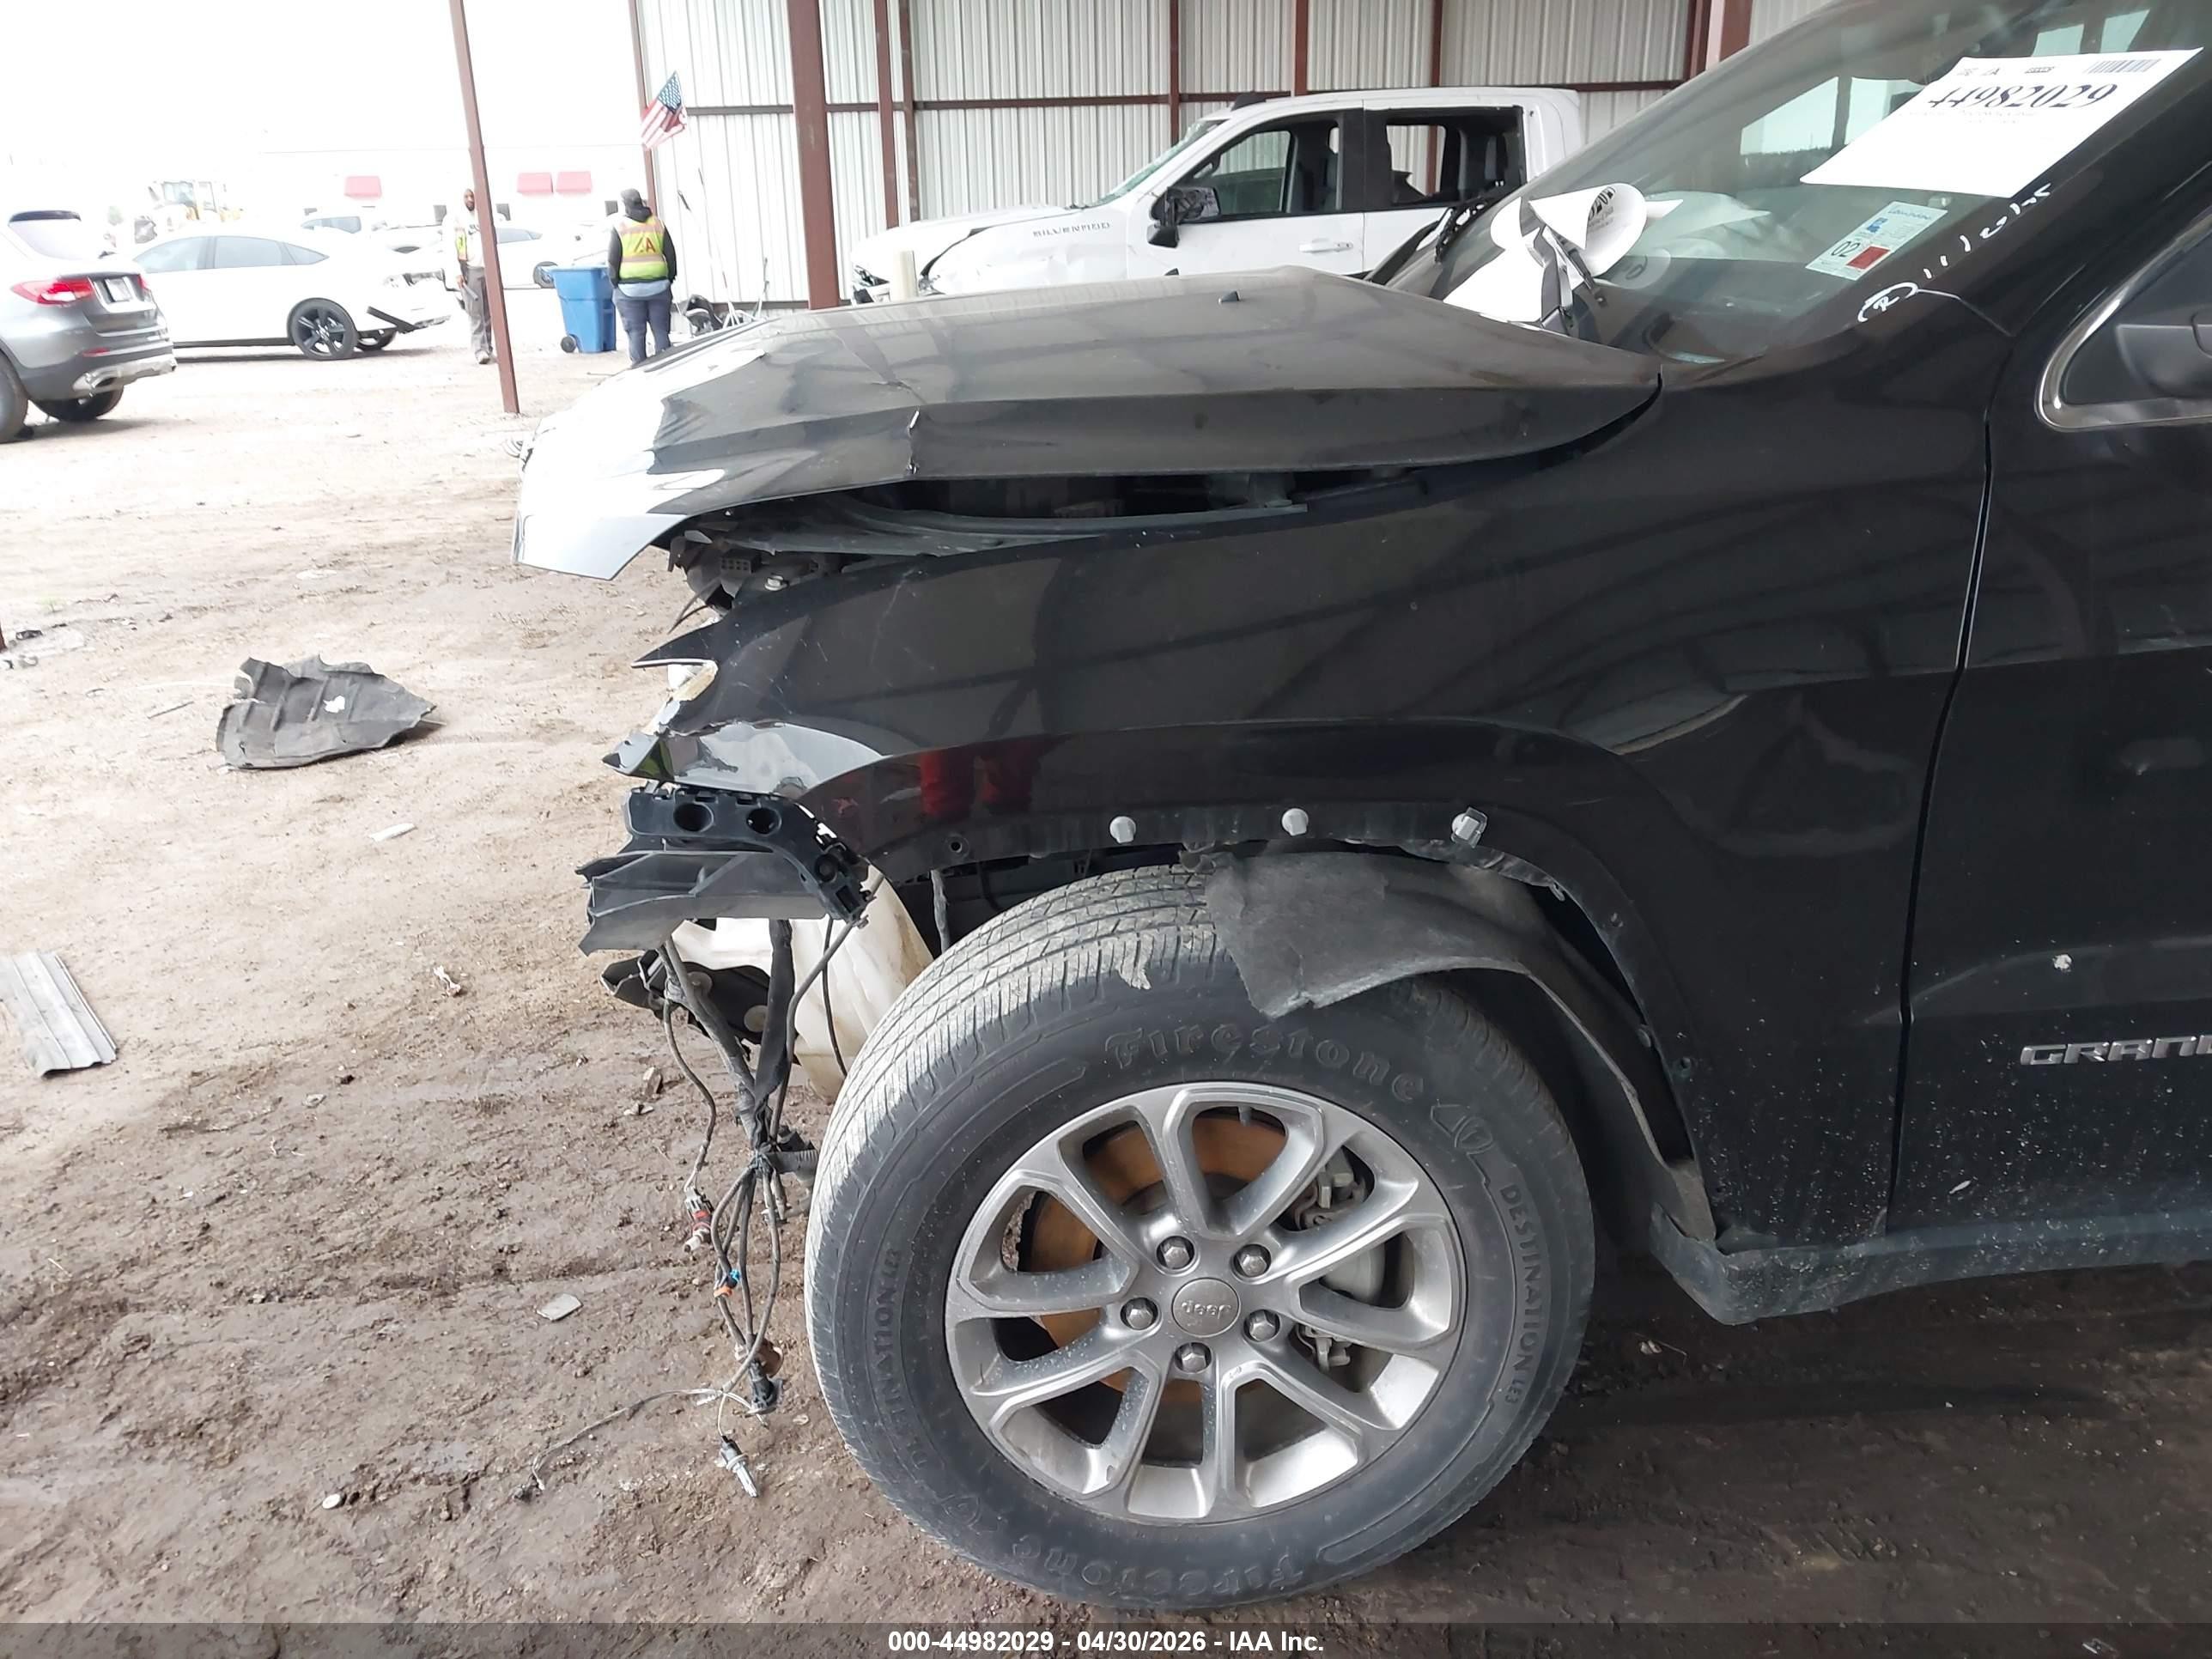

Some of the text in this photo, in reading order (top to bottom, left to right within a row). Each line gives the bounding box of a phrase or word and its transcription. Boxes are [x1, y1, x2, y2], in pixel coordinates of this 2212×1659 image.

[1929, 83, 2118, 108] 44982029
[1831, 240, 1861, 258] 02
[1104, 1024, 1424, 1103] Firestone
[1499, 1183, 1543, 1371] DESTINATION
